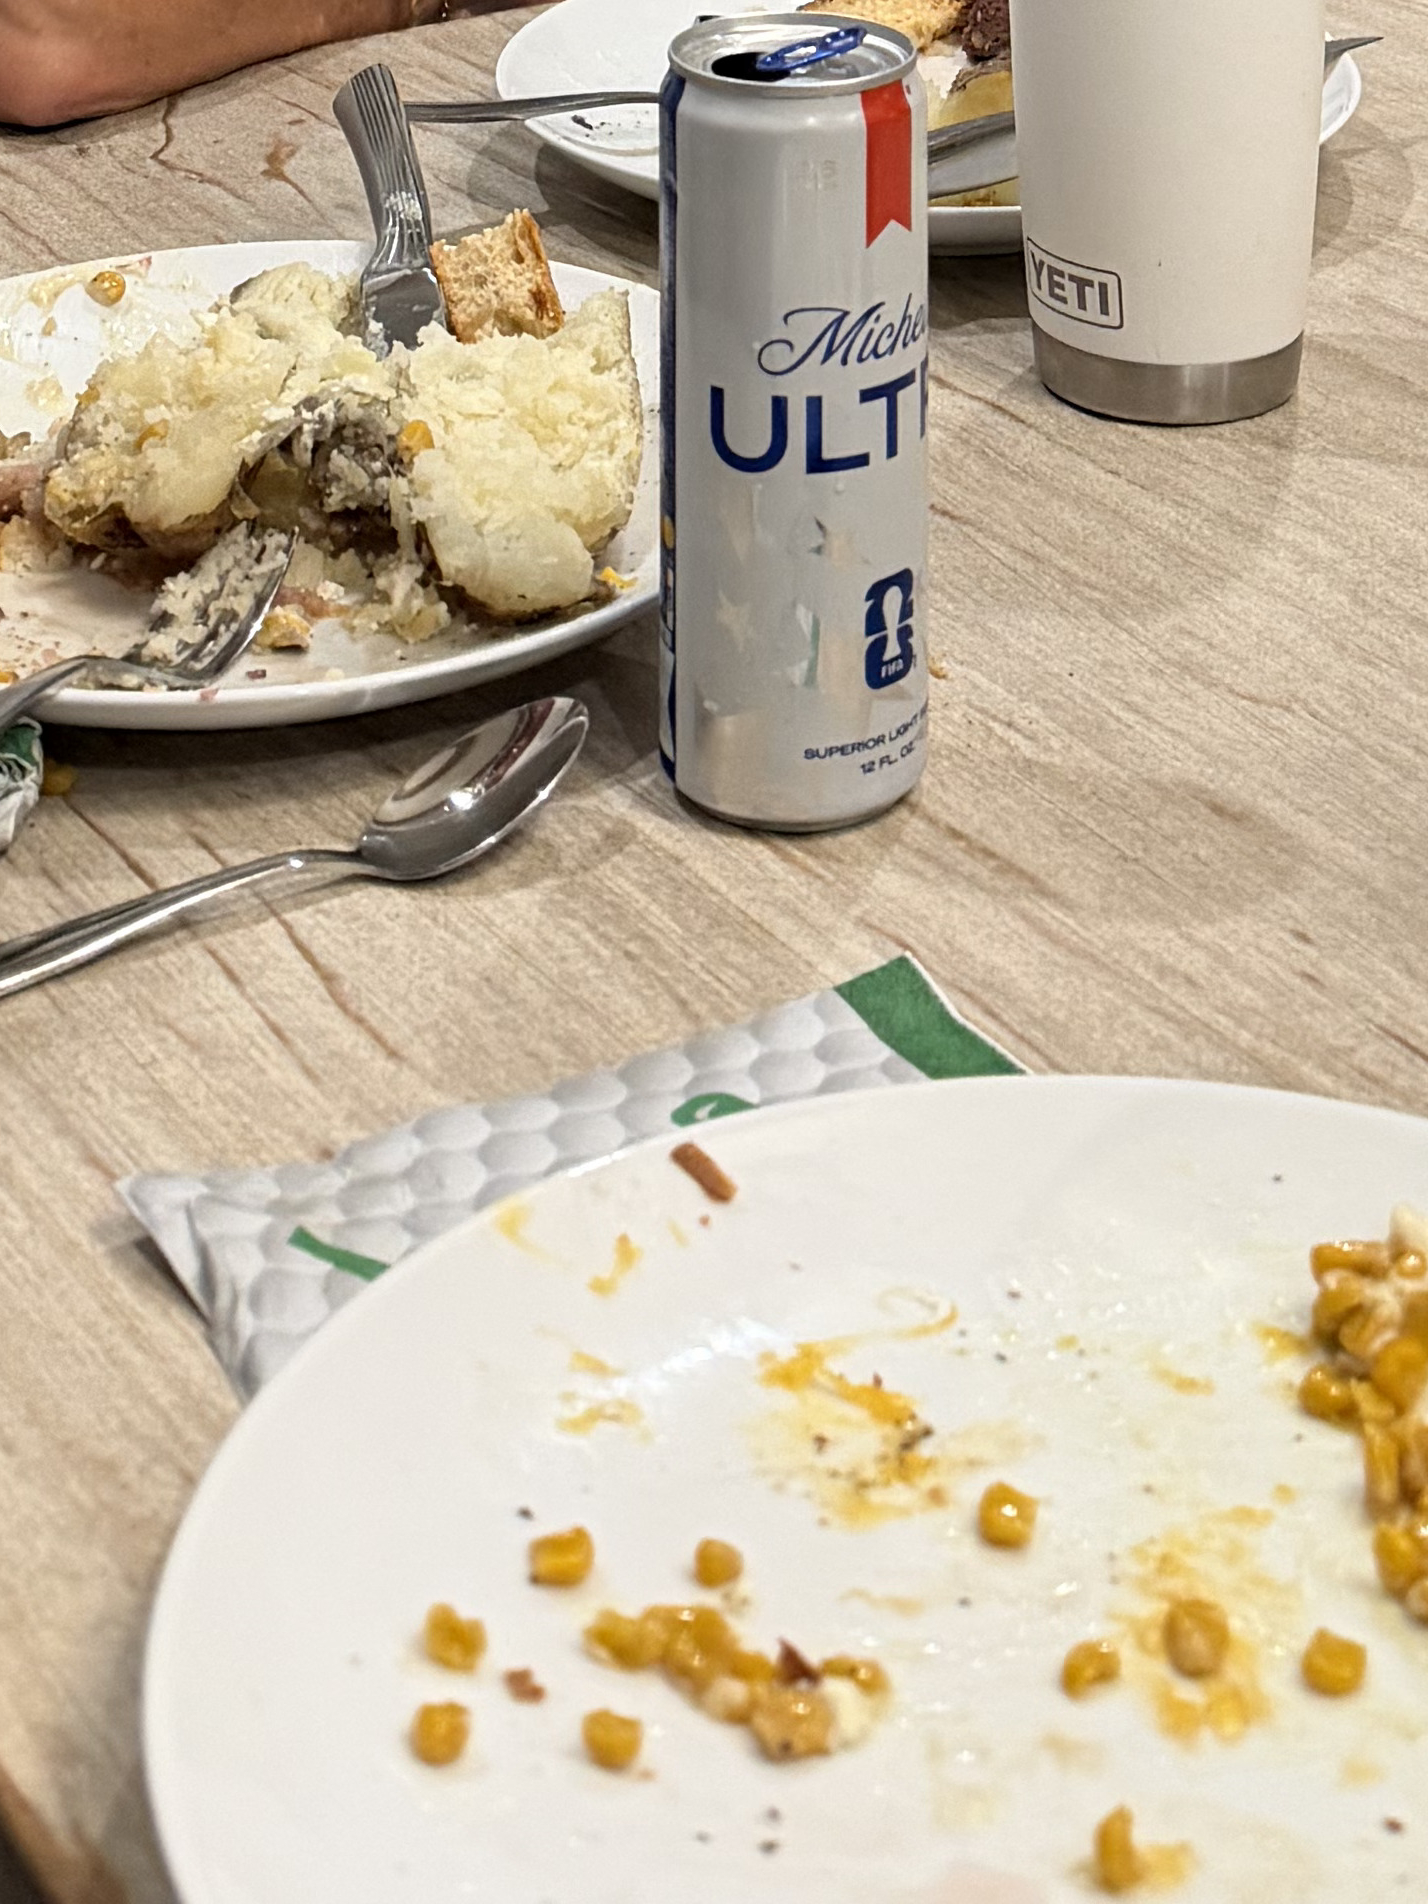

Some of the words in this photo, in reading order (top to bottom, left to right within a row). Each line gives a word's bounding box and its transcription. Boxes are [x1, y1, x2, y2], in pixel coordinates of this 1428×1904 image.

[1029, 249, 1110, 316] YETI
[757, 292, 926, 376] Miche
[710, 350, 929, 474] ULT
[803, 733, 886, 760] SUPERIOR
[859, 760, 876, 774] 12
